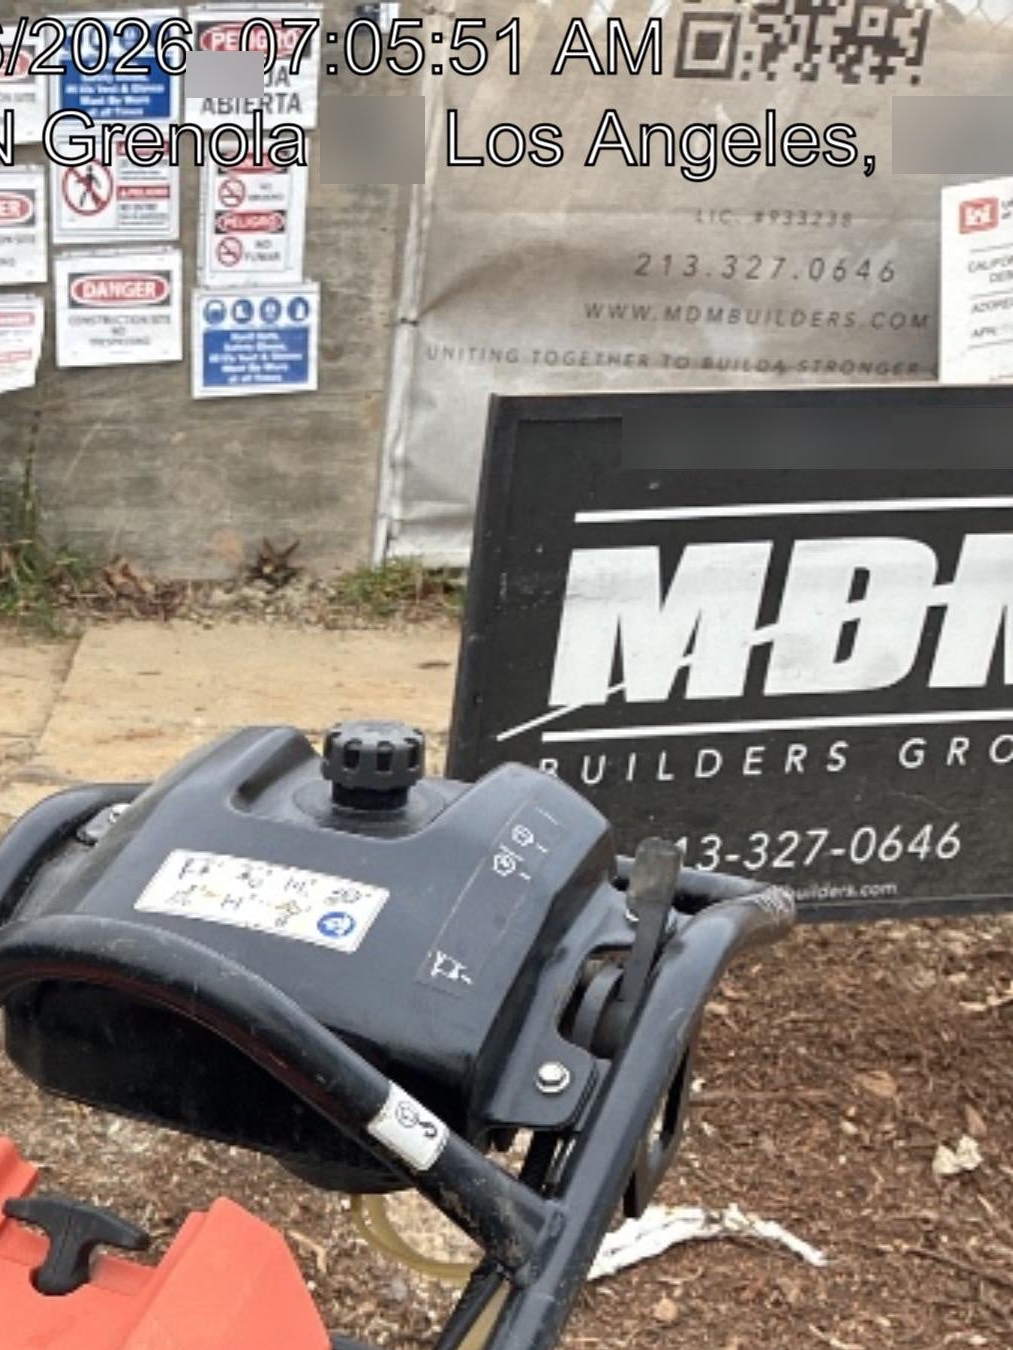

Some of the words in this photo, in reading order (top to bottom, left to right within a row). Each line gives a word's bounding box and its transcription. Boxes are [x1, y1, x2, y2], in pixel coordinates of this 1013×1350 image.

[199, 92, 303, 115] ABIERTA
[634, 253, 895, 283] 213.327.0646
[83, 281, 157, 298] DANGER
[425, 345, 520, 365] UNITING
[532, 349, 649, 369] TOGETHER
[674, 821, 962, 872] 13-327-0646
